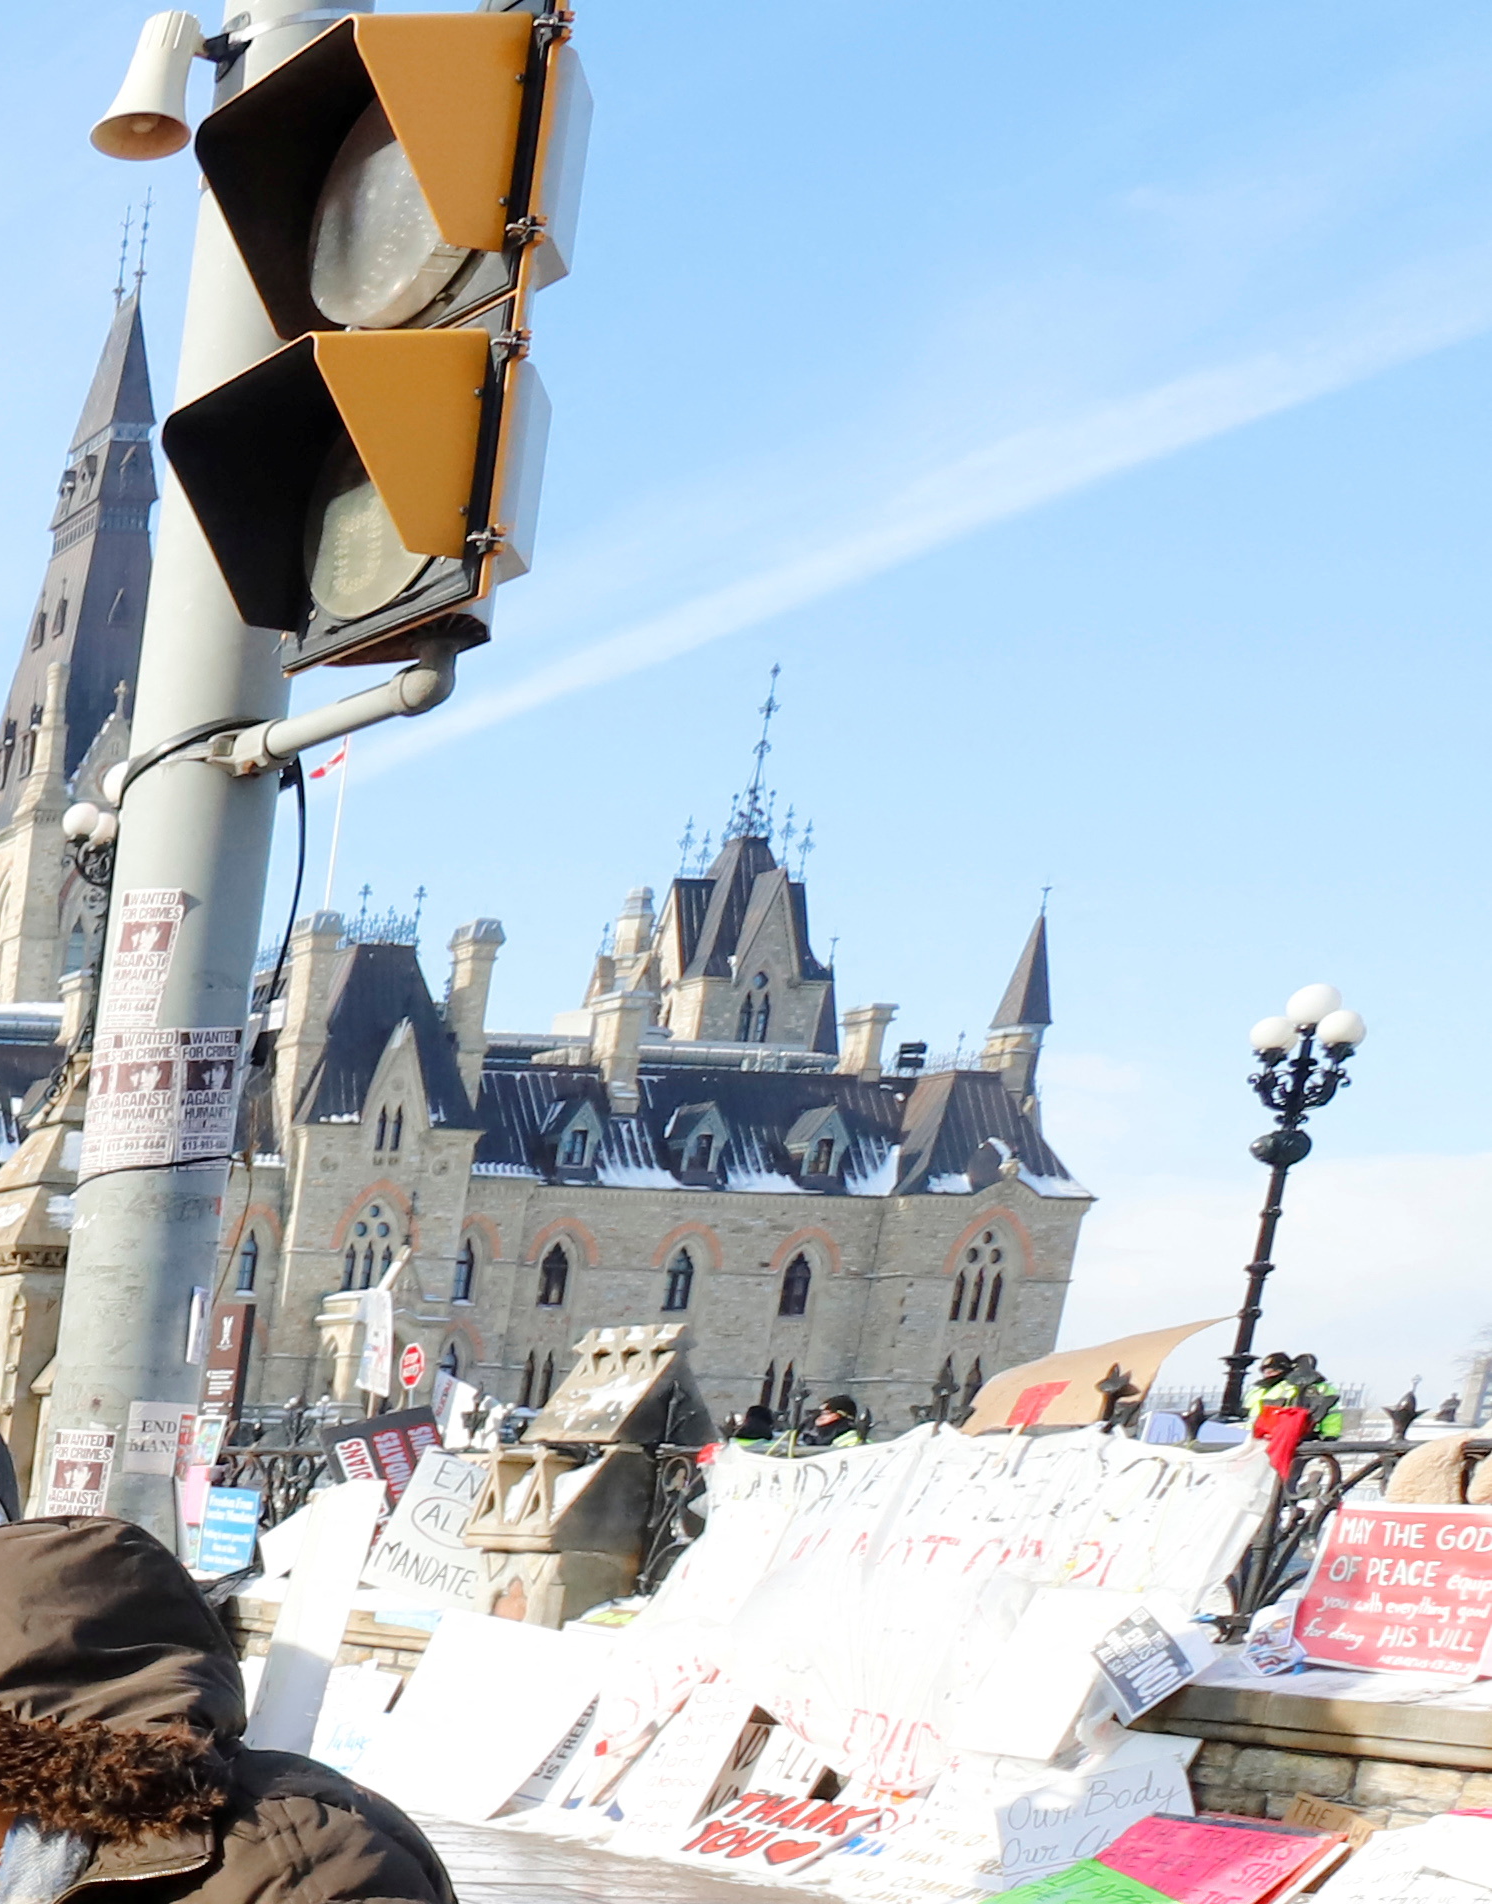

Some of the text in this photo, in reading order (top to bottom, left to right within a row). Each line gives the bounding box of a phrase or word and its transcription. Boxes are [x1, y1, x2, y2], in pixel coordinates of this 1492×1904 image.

[130, 892, 177, 906] WANTED
[140, 907, 181, 920] CRIMES
[124, 1032, 173, 1046] WANTED
[193, 1031, 235, 1044] WANTED
[136, 1047, 178, 1058] CRIMES
[183, 1047, 203, 1058] FOR
[114, 1092, 167, 1107] AGAINST
[141, 1420, 177, 1434] END
[61, 1435, 104, 1447] WANTED
[72, 1448, 111, 1460] CRIMES
[1338, 1518, 1492, 1553] MAY THE GOD
[1328, 1556, 1442, 1587] OF PEACE
[1316, 1593, 1490, 1623] you with everything good
[1303, 1617, 1474, 1652] for doing HIS WILL
[1008, 1771, 1185, 1830] Our Body
[728, 1791, 878, 1836] THANK
[1293, 1798, 1333, 1829] THE
[683, 1820, 779, 1858] YOU
[1001, 1838, 1058, 1868] Our
